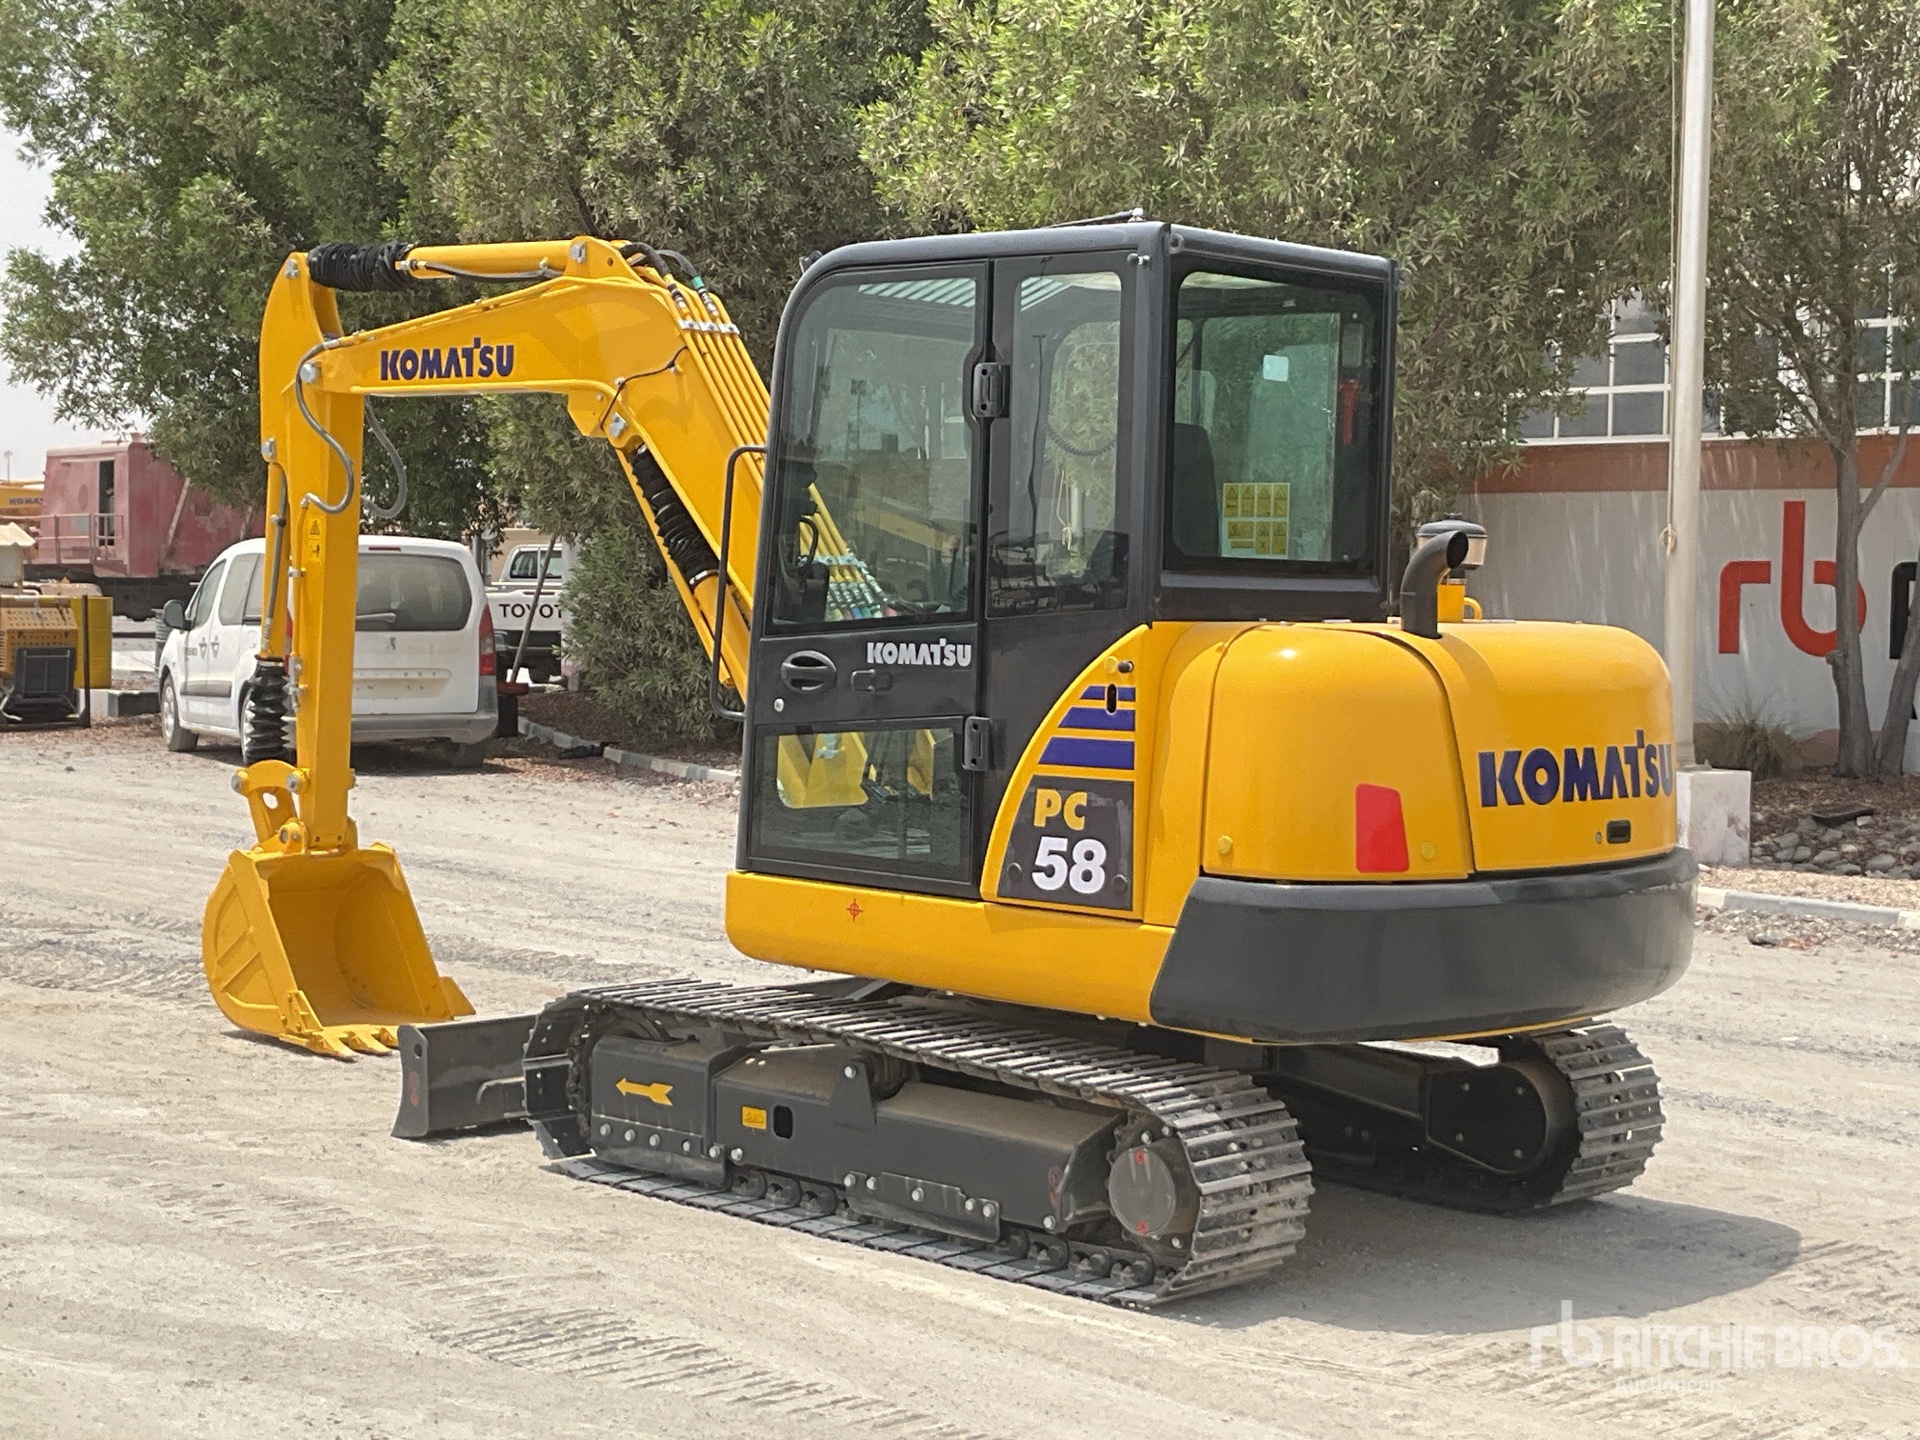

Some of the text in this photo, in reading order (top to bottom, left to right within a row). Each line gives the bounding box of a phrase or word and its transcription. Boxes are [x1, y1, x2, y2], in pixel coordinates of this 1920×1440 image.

[381, 337, 514, 380] KOMATSU
[867, 638, 972, 667] KOMATSU
[1479, 729, 1673, 807] KOMATSU
[1034, 788, 1088, 831] PC
[1032, 836, 1107, 894] 58
